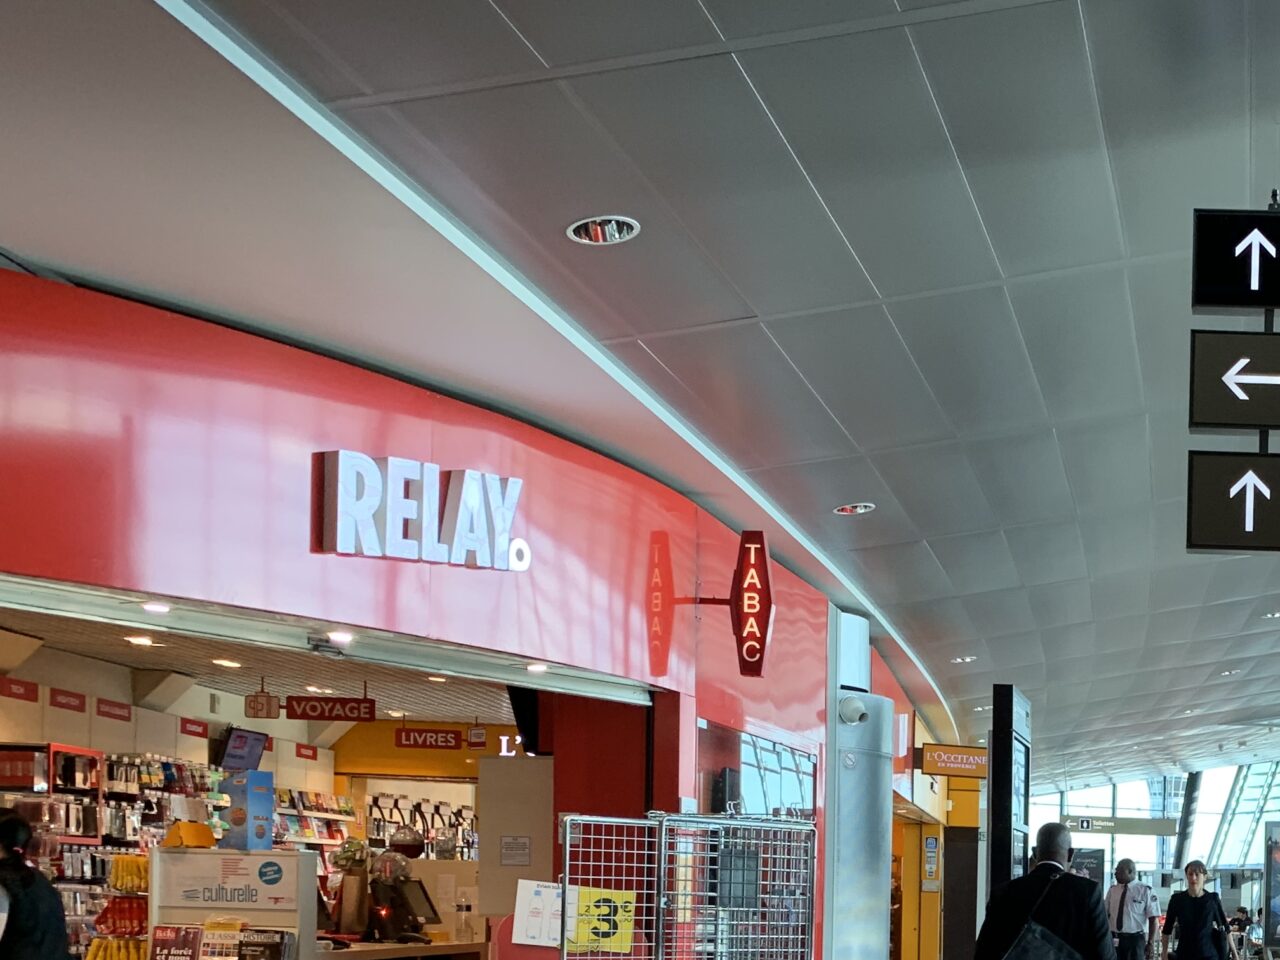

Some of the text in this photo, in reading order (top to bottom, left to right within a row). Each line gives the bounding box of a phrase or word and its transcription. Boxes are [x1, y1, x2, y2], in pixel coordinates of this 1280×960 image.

[742, 543, 762, 662] TABAC
[291, 699, 372, 718] VOYAGE
[400, 731, 456, 747] LIVRES
[202, 883, 258, 903] culturelle
[590, 897, 619, 939] 3
